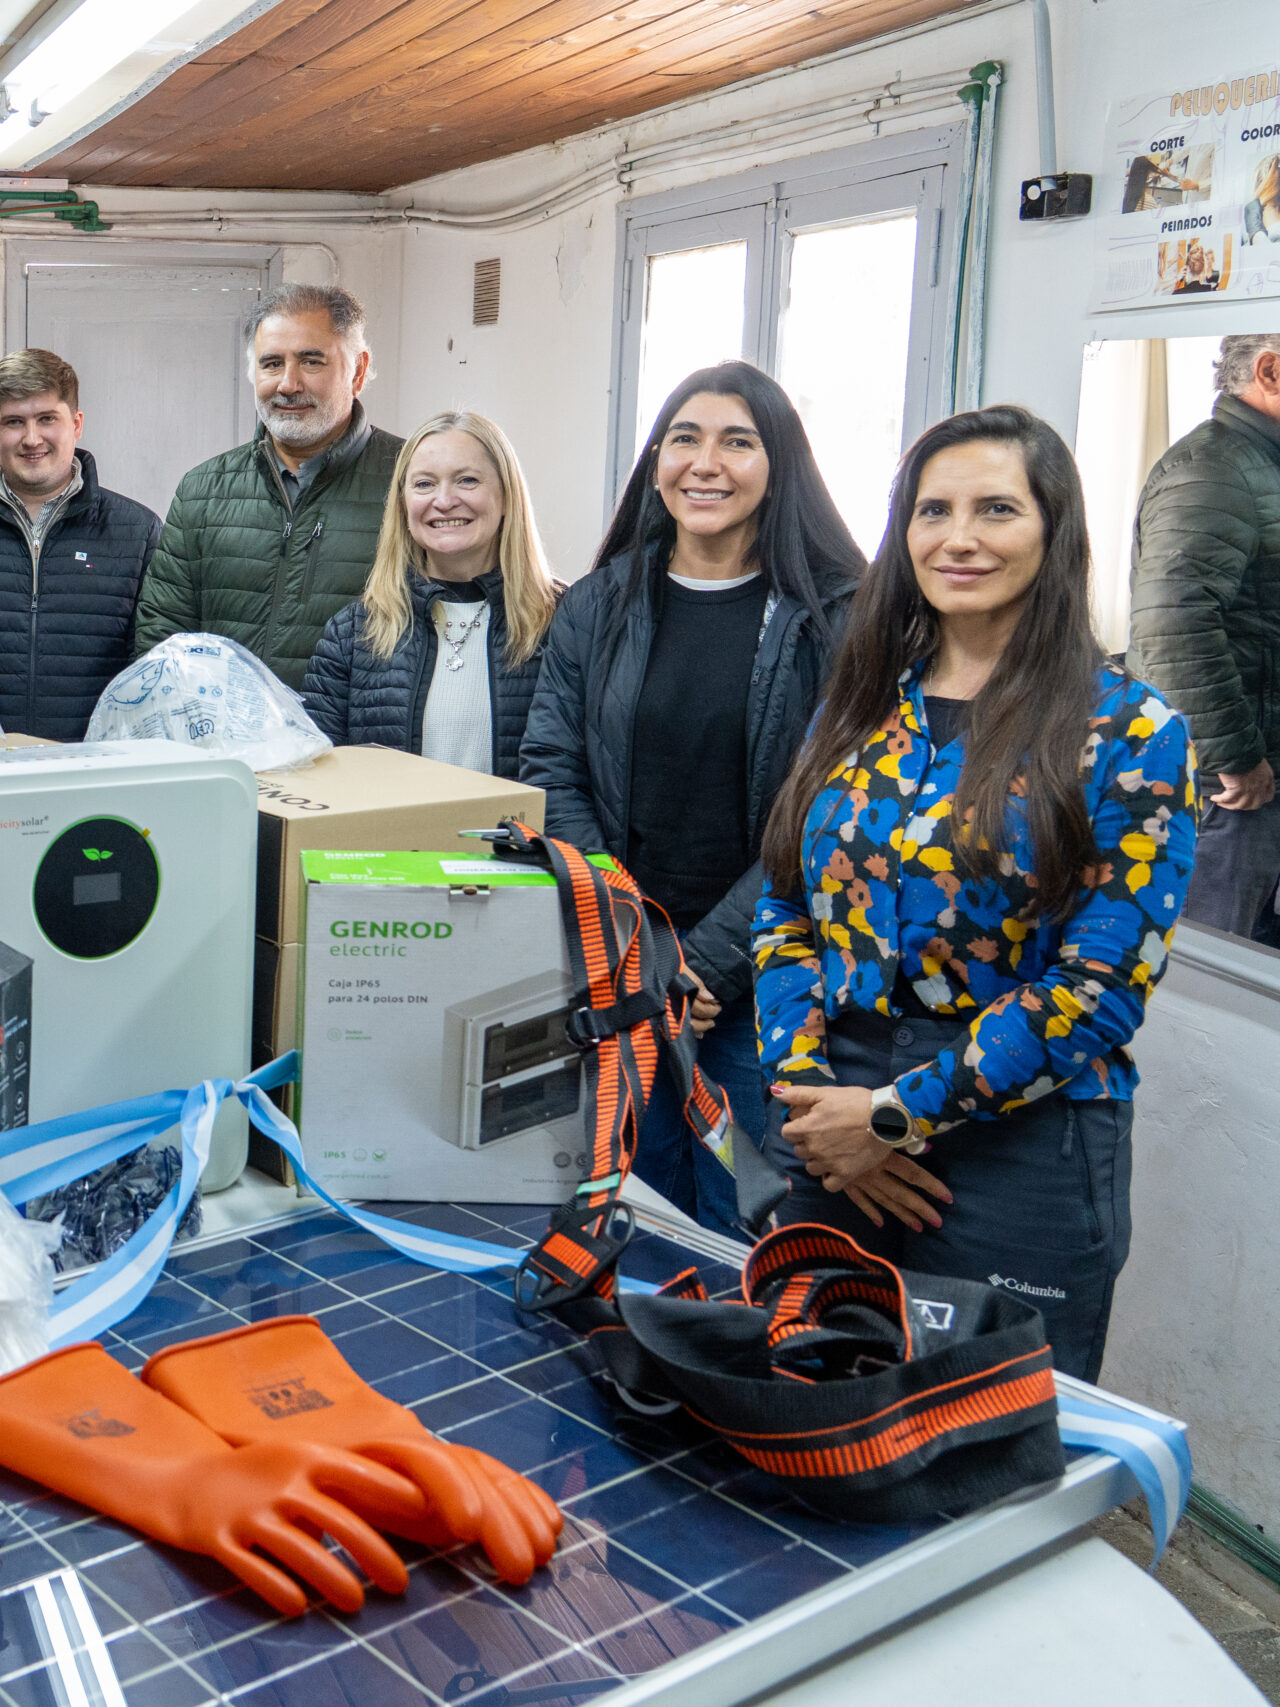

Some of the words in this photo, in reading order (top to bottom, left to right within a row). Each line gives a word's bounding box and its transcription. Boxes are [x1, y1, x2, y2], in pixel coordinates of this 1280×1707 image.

[1170, 70, 1280, 117] PELUQUERI
[1150, 136, 1185, 153] CORTE
[1161, 215, 1213, 233] PEINADOS
[329, 920, 453, 939] GENROD
[329, 943, 407, 957] electric
[328, 979, 352, 989] Caja
[355, 979, 380, 988] IP65
[328, 995, 353, 1004] para
[373, 995, 404, 1004] polos
[407, 995, 428, 1003] DIN
[1004, 1277, 1066, 1299] Columbia
